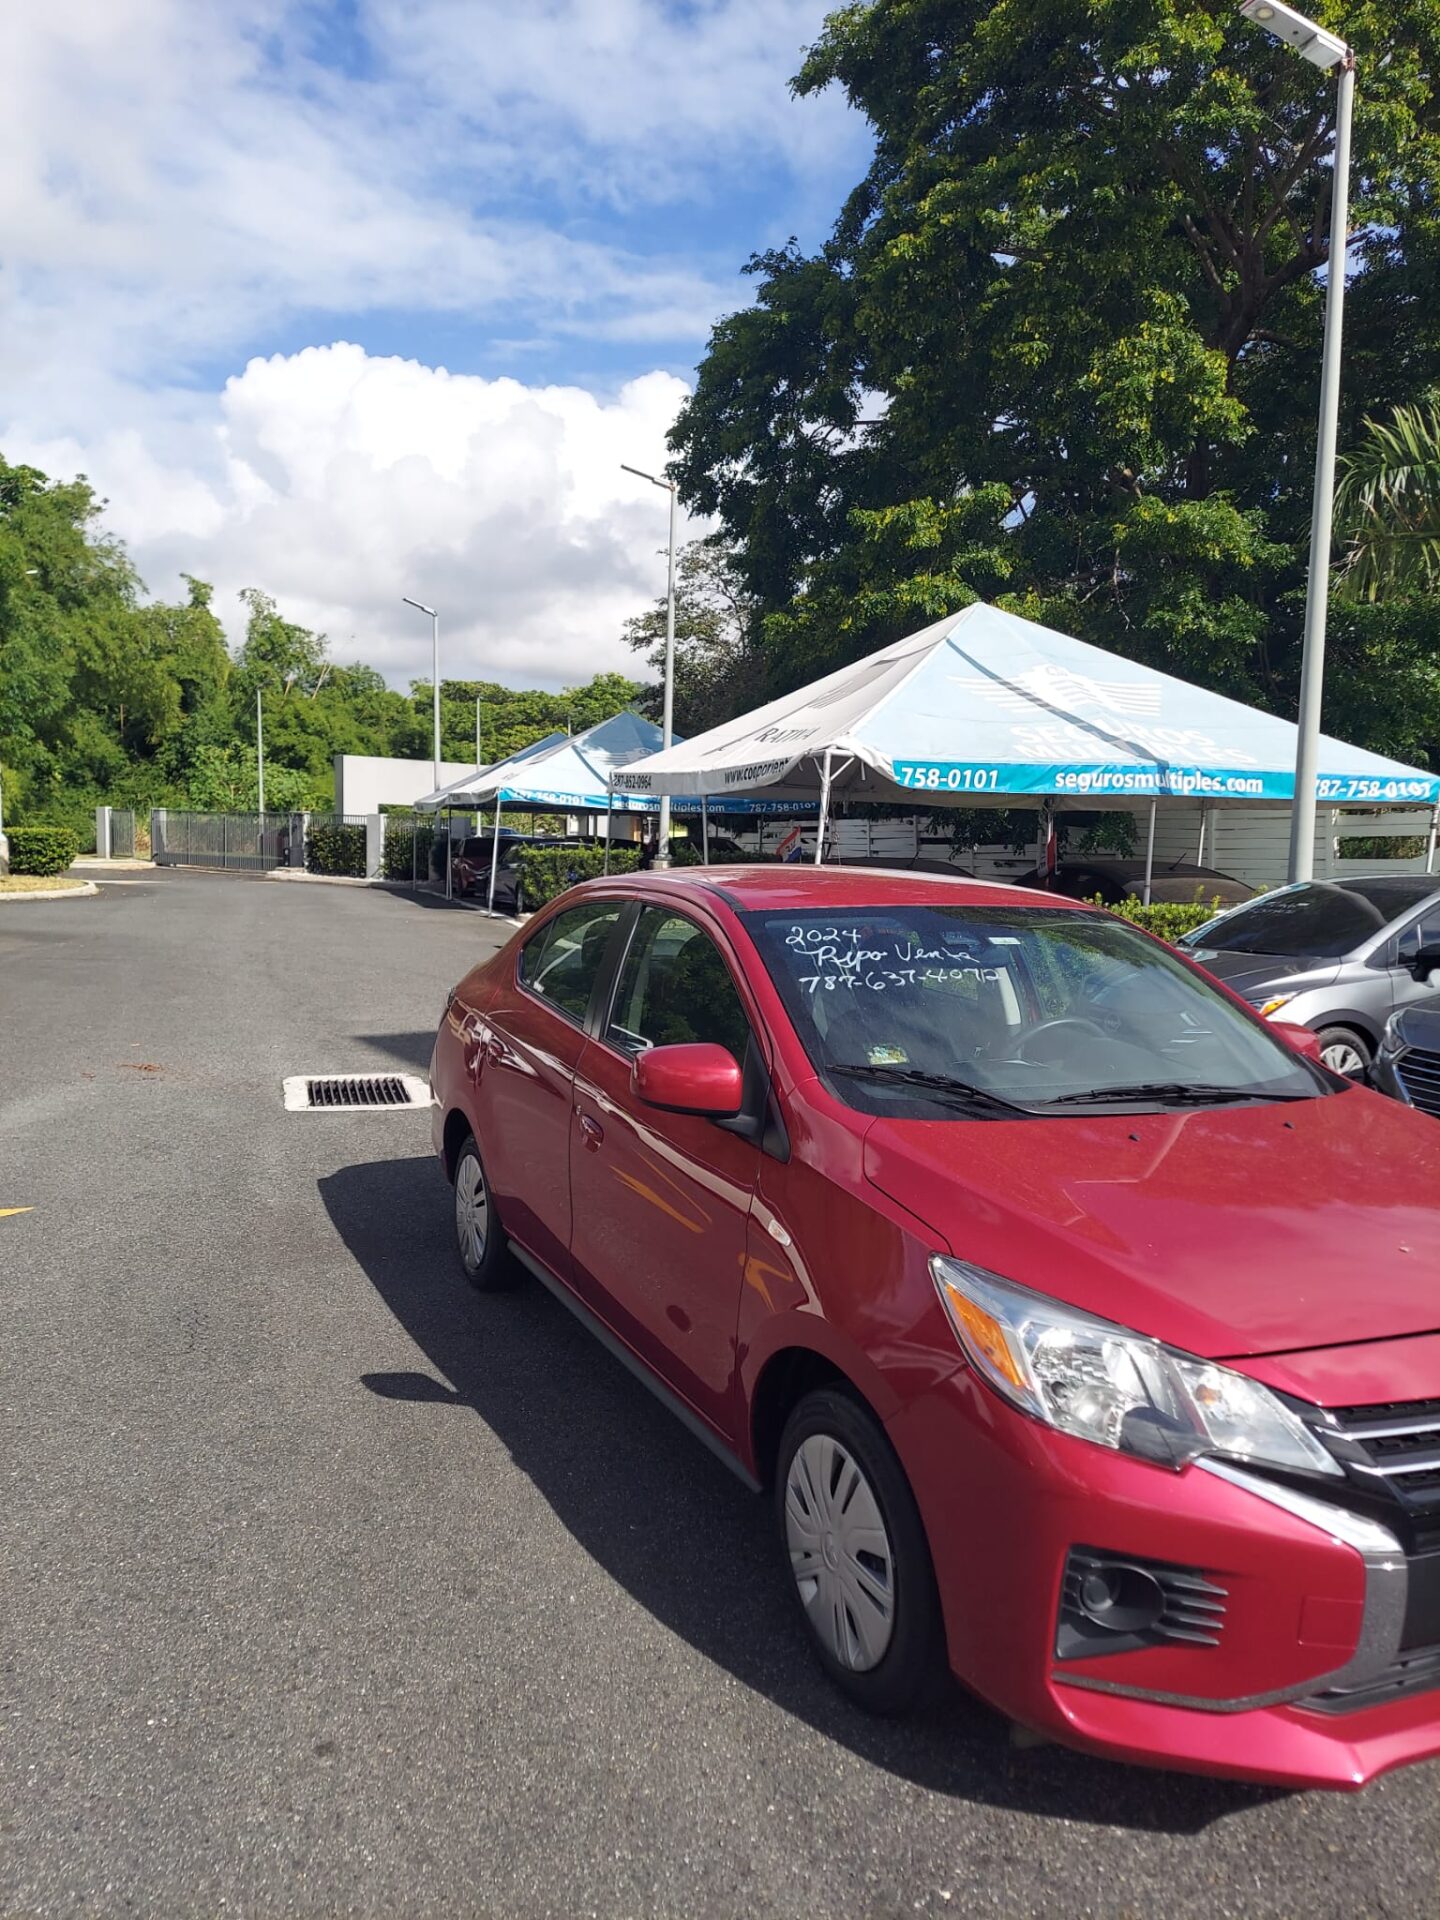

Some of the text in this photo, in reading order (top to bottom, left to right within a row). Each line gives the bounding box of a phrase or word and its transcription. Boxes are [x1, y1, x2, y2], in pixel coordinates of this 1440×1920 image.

[1014, 737, 1258, 764] MULIPLES
[1055, 768, 1263, 795] segurosmultiples.com
[612, 799, 726, 813] segurosmltiples.com
[785, 925, 862, 946] 2024
